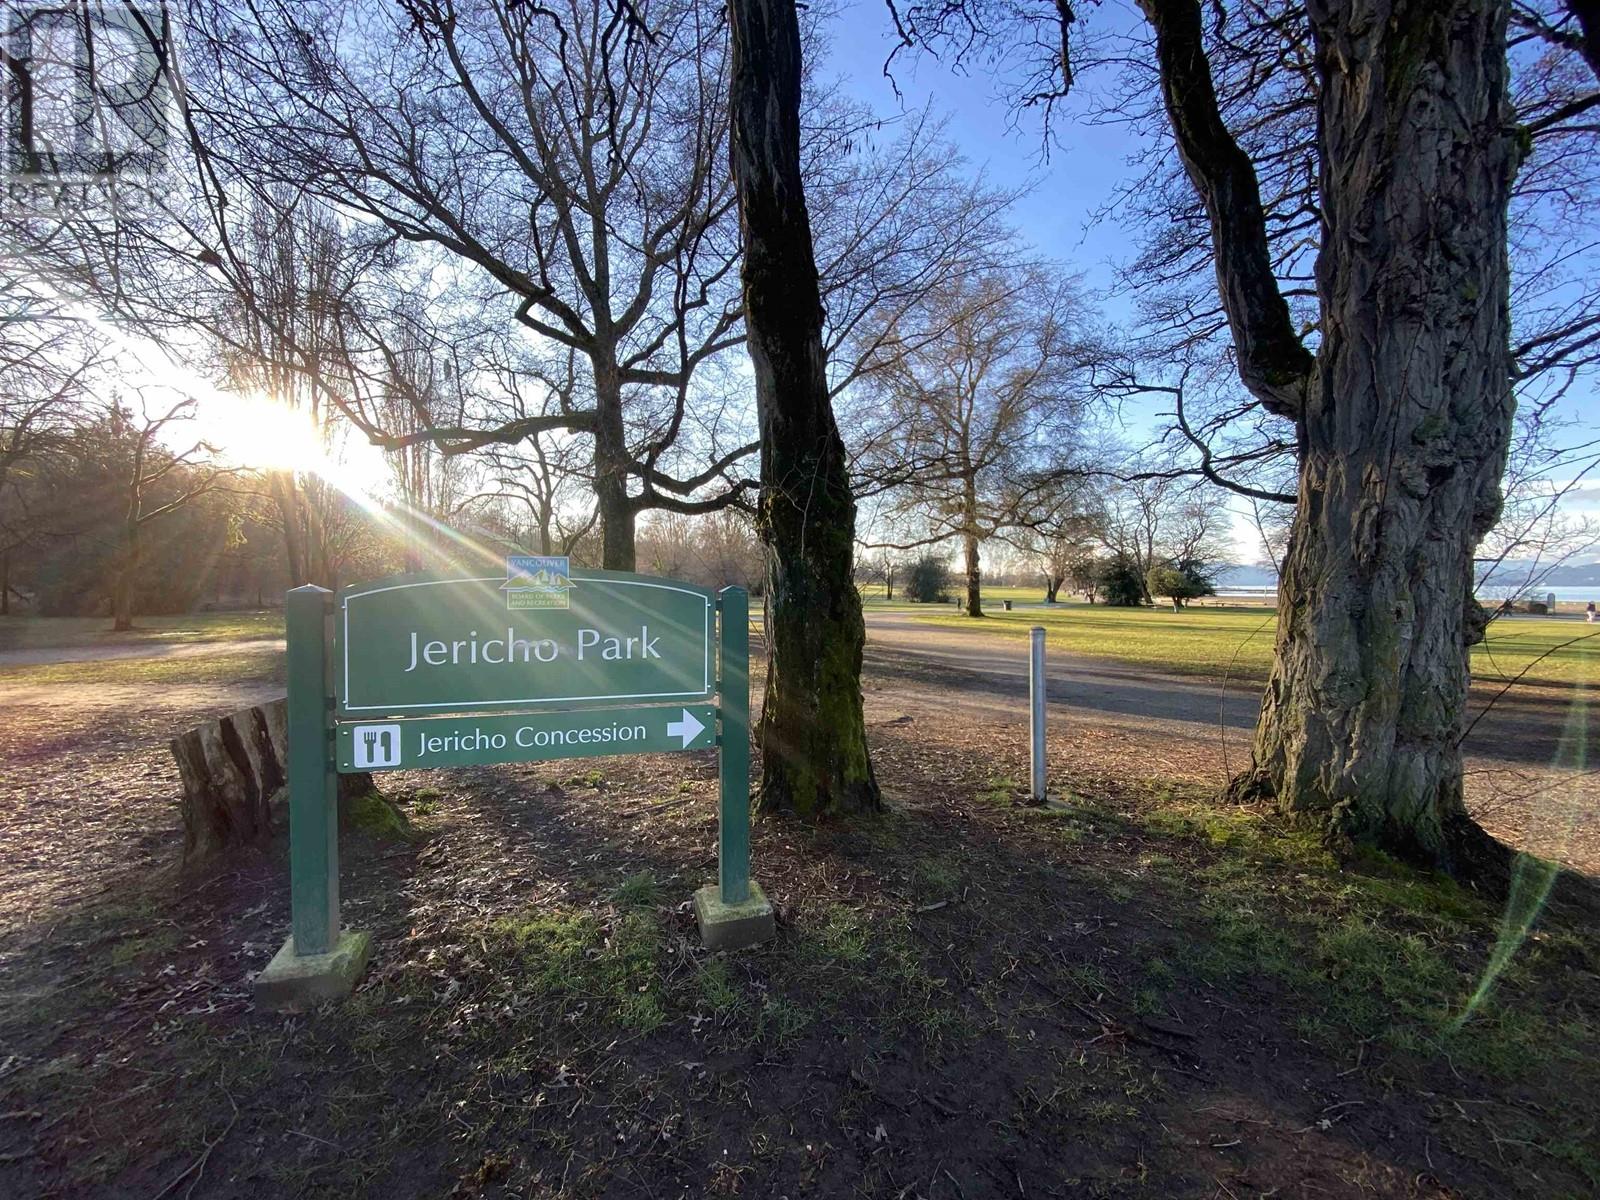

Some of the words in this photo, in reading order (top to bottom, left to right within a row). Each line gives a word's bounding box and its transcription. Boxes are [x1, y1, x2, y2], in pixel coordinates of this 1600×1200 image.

[404, 627, 559, 672] Jericho
[577, 625, 661, 661] Park
[417, 728, 507, 757] Jericho
[515, 722, 646, 748] Concession
